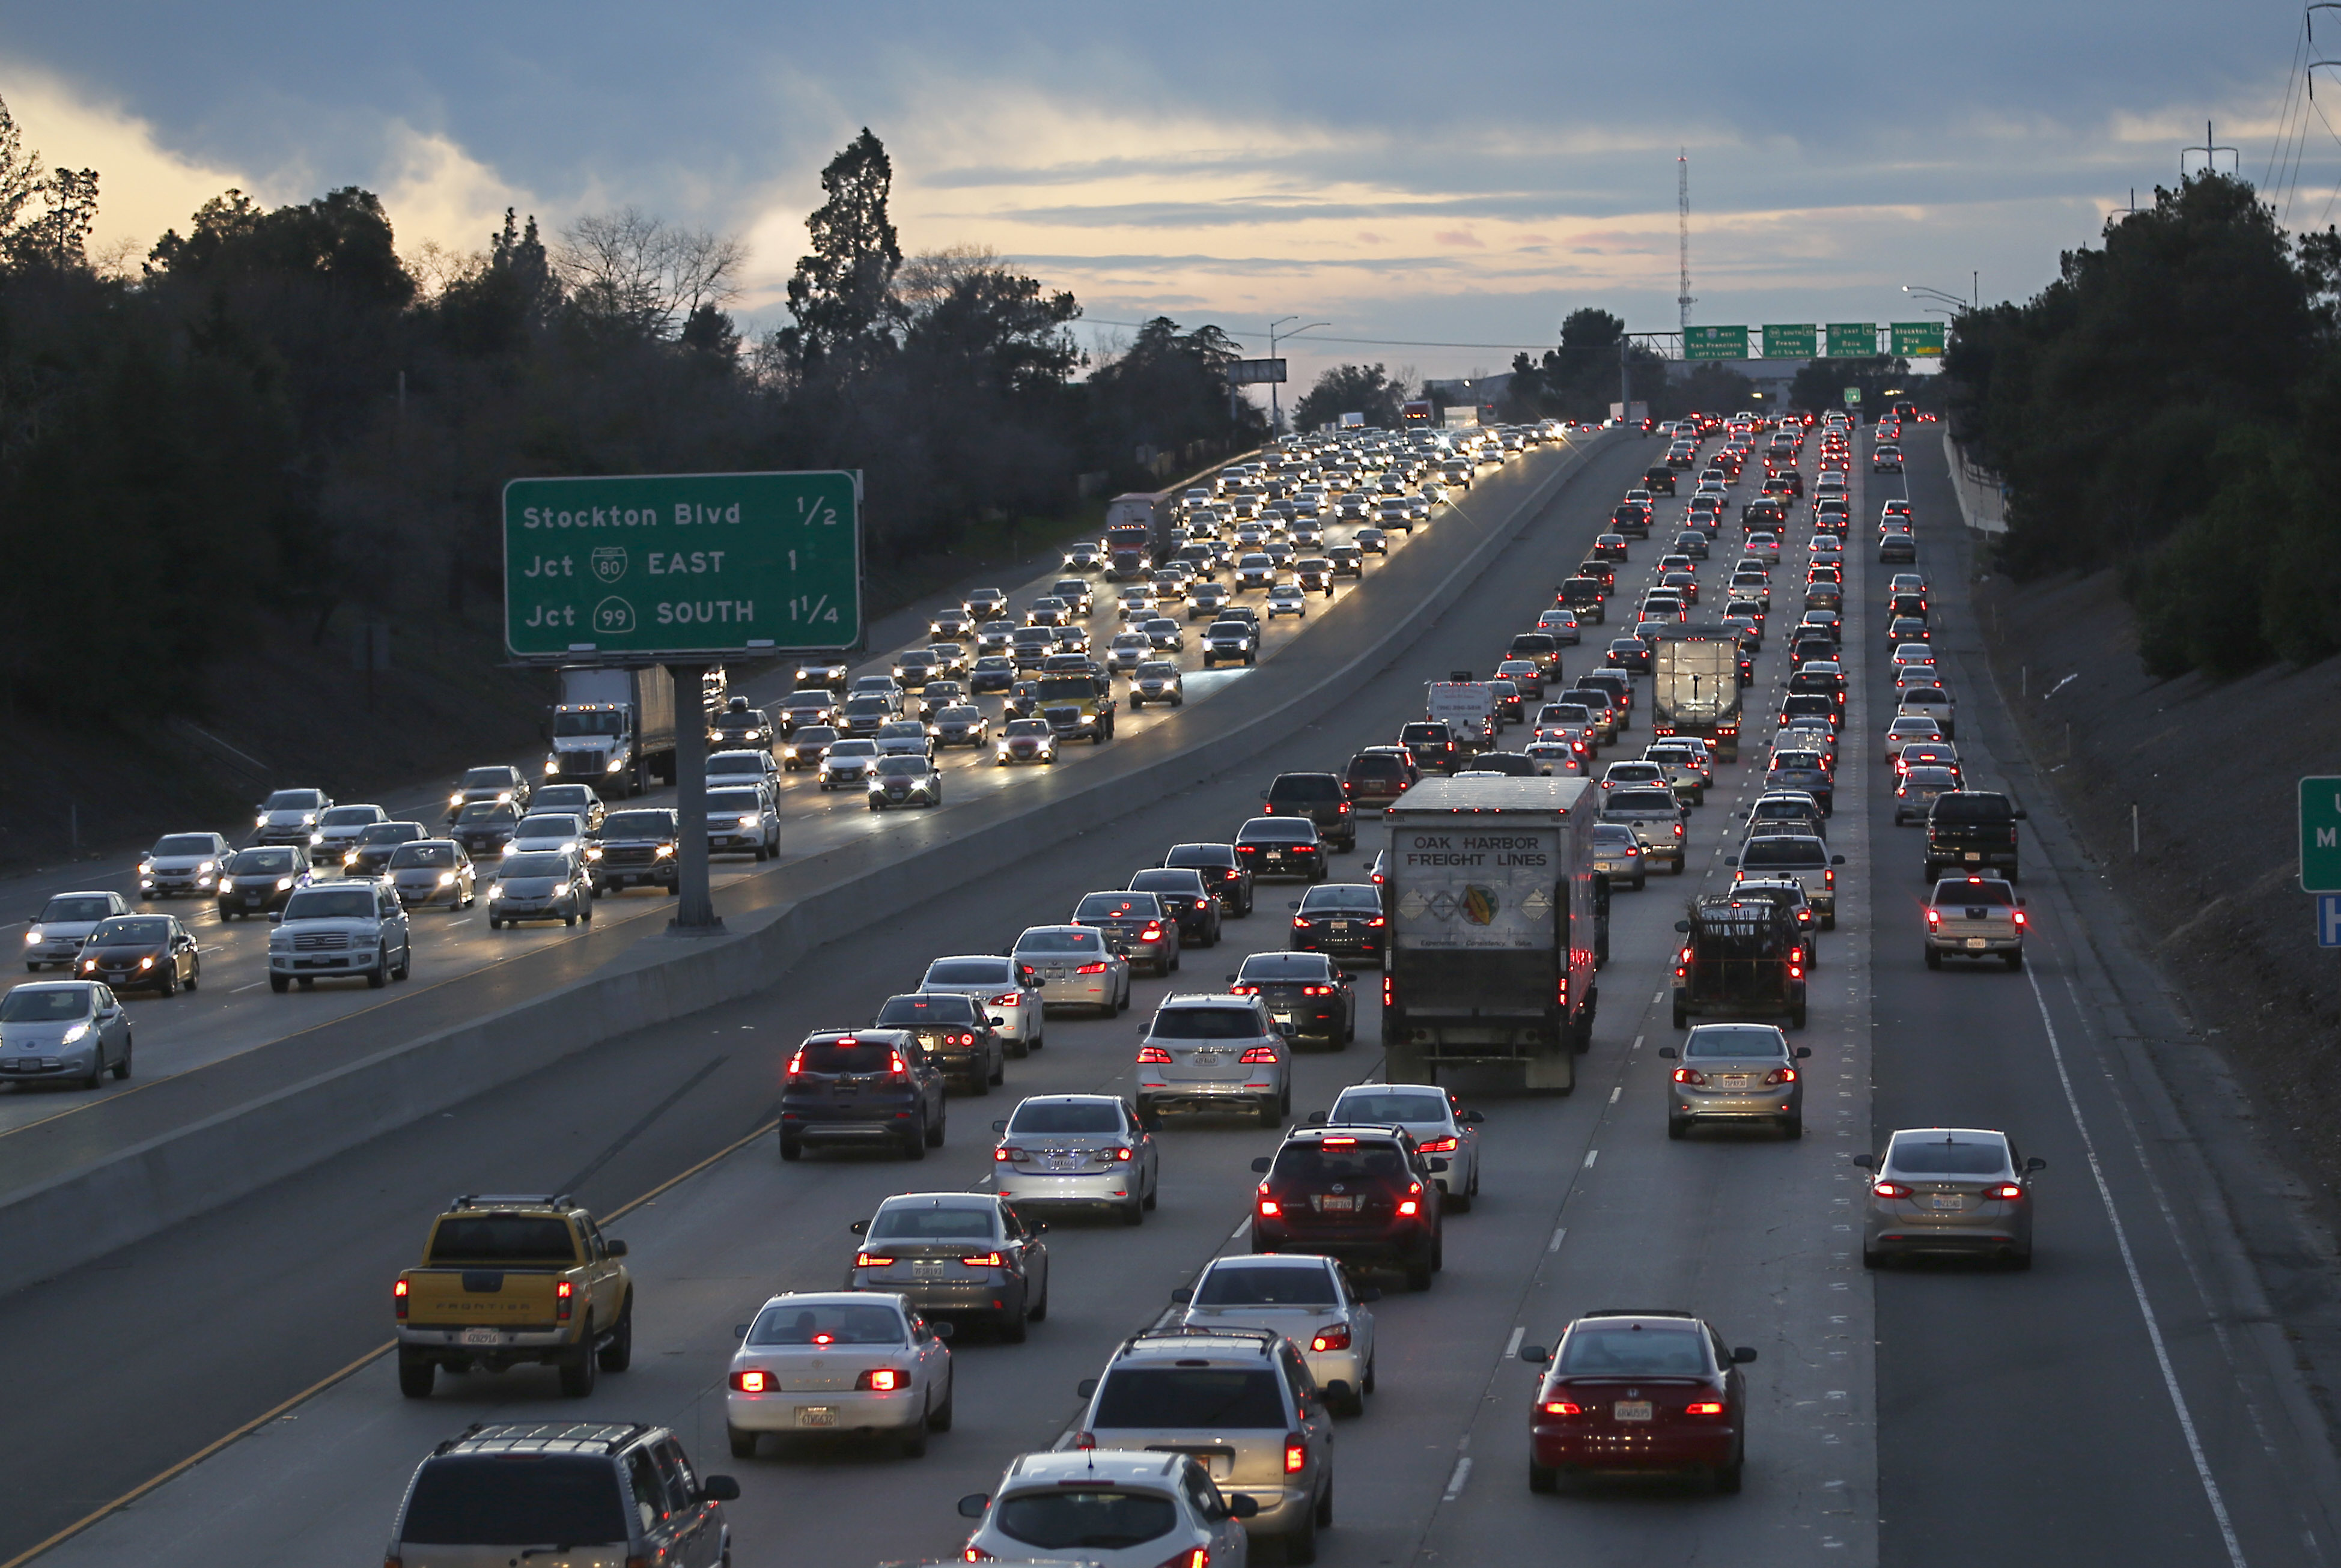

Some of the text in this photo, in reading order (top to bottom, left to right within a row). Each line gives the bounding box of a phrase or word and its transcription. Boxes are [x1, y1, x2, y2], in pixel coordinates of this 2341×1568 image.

[523, 506, 657, 529] Stockton
[675, 502, 740, 525] Blvd
[524, 549, 796, 577] Jct 80 EAST 1
[525, 605, 575, 627] Jct
[601, 609, 626, 627] 99
[657, 600, 753, 624] SOUTH
[1414, 836, 1539, 849] OAK HARBOR
[1407, 853, 1547, 866] FREIGHT LINES
